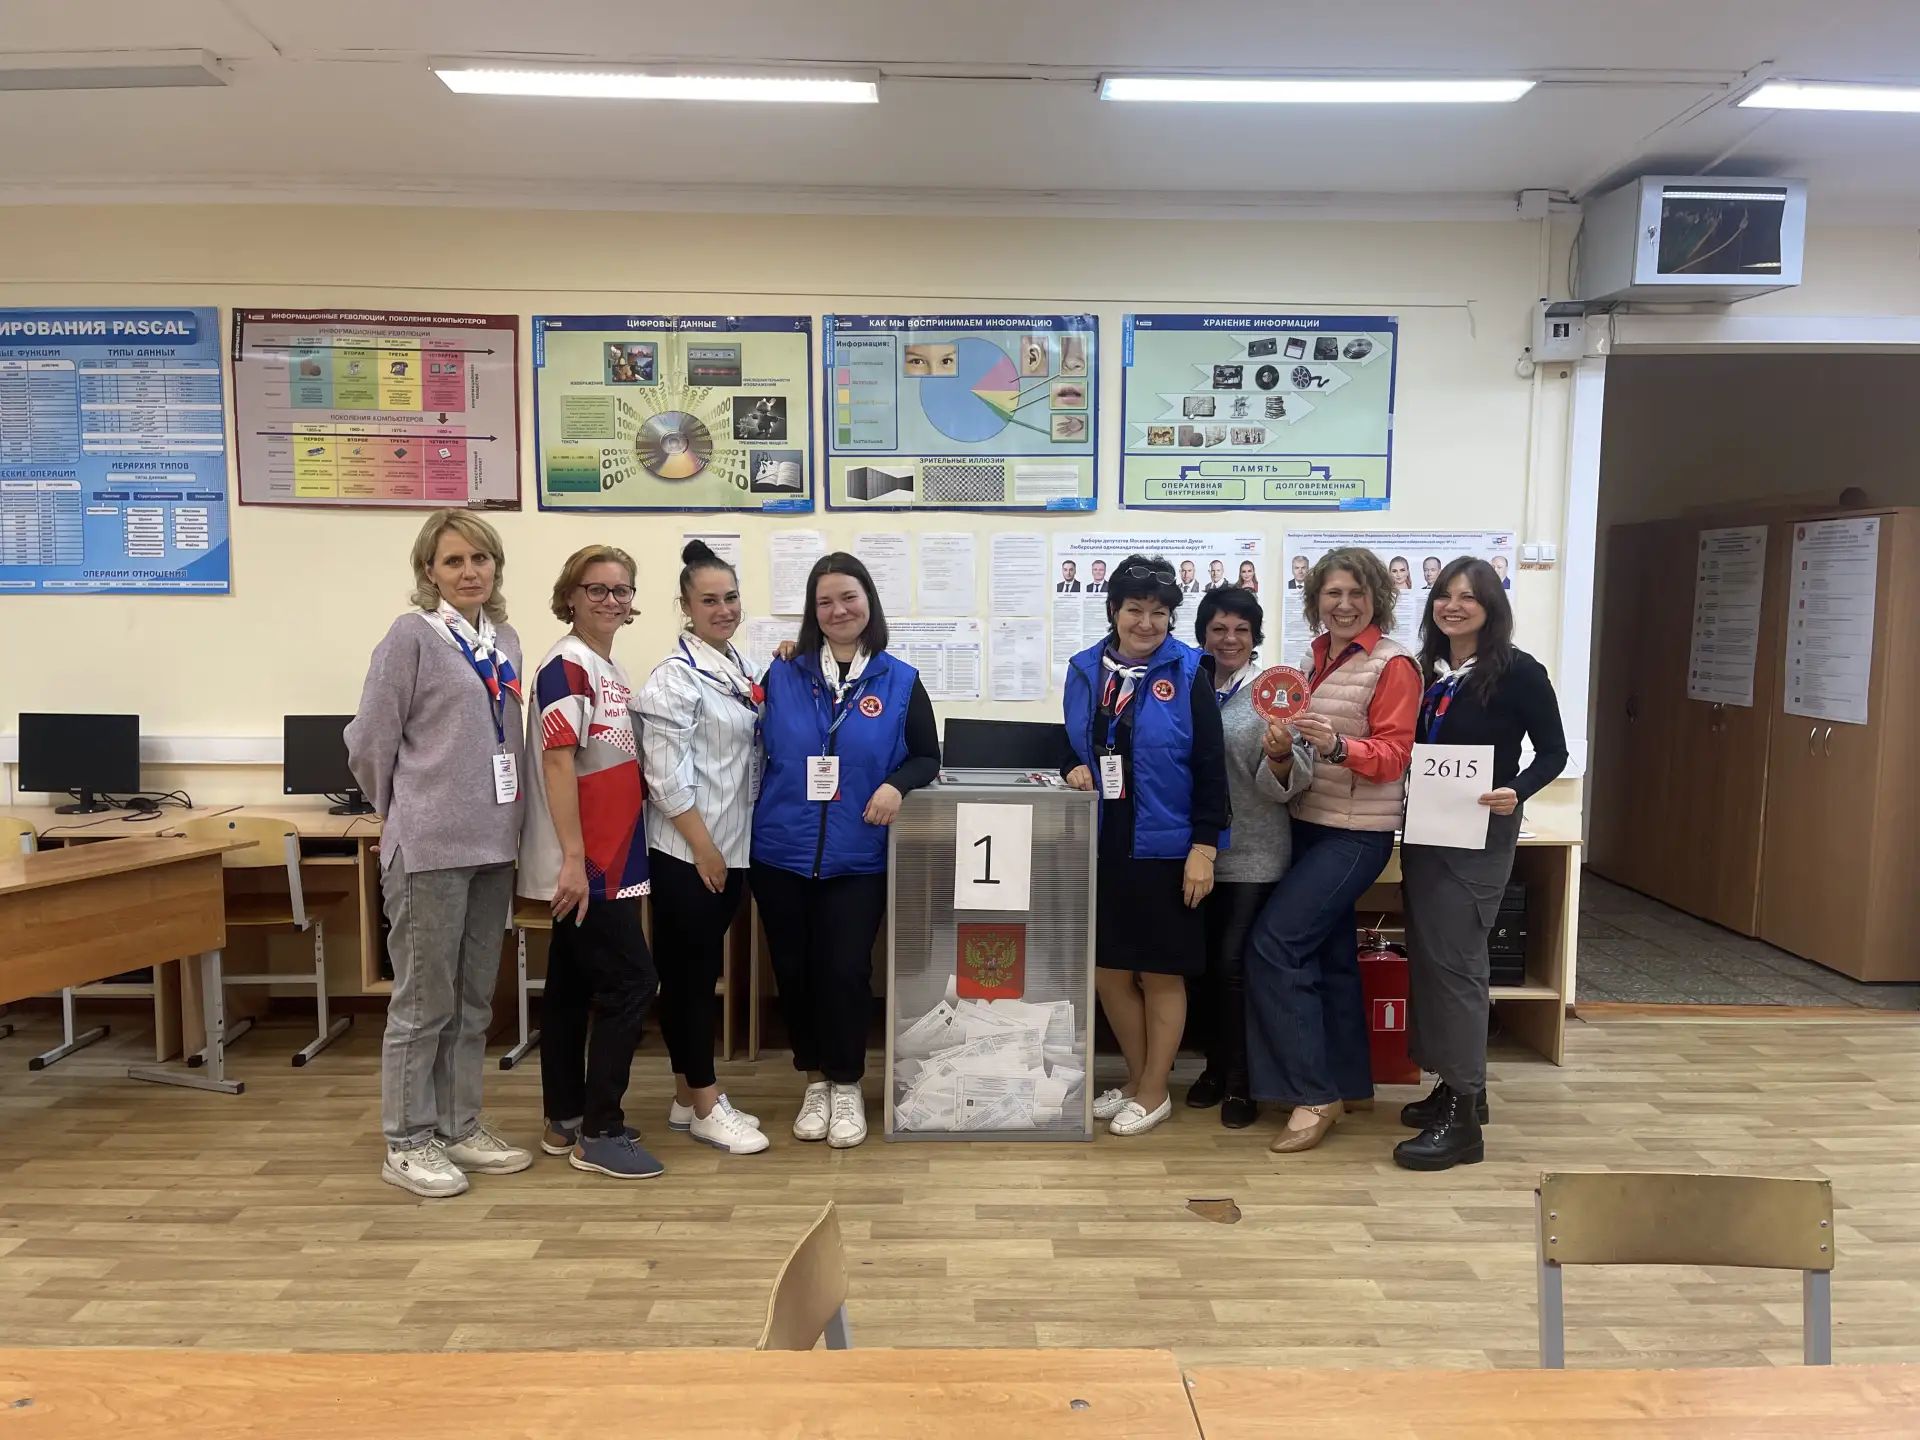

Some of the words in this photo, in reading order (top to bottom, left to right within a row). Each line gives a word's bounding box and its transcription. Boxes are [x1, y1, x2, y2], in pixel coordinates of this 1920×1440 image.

[340, 314, 388, 322] РЕВОЛЮЦИИ,
[432, 316, 486, 324] КОМПЬЮТЕРОВ
[626, 320, 678, 328] ЦИФРОВЫЕ
[680, 320, 716, 328] ДАННЫЕ
[986, 319, 1052, 328] ИНФОРМАЦИЮ
[1254, 320, 1320, 328] ИНФОРМАЦИИ
[113, 320, 190, 335] PASCAL
[1424, 758, 1478, 778] 2615
[972, 835, 1000, 884] 1
